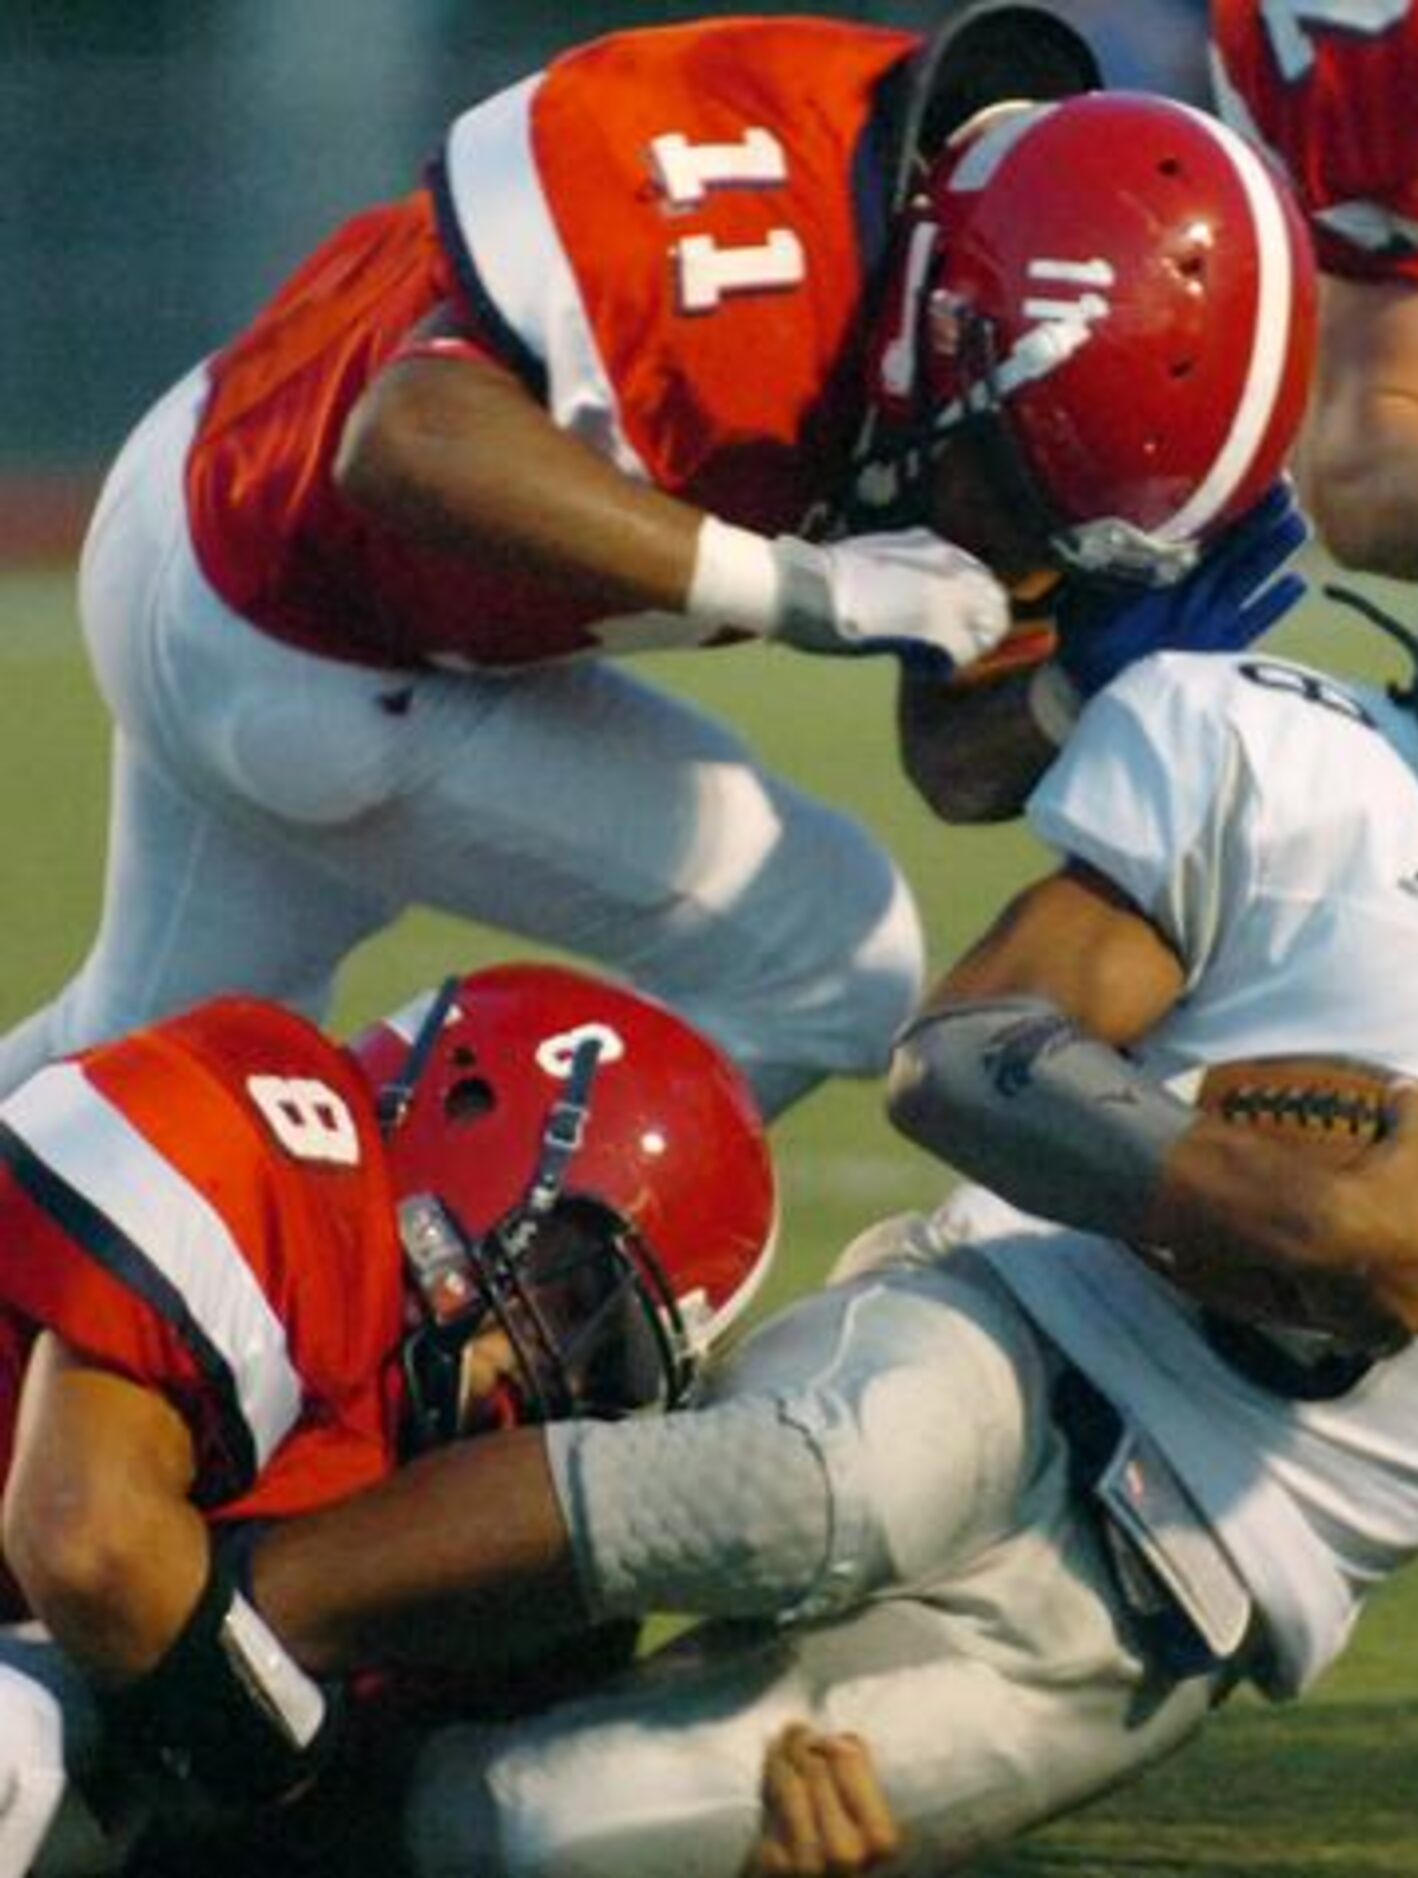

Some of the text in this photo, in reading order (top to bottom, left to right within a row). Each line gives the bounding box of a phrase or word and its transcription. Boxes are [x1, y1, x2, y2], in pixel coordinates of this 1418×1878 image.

[651, 124, 808, 314] 11
[1238, 662, 1376, 729] 8
[246, 1074, 360, 1166] 8
